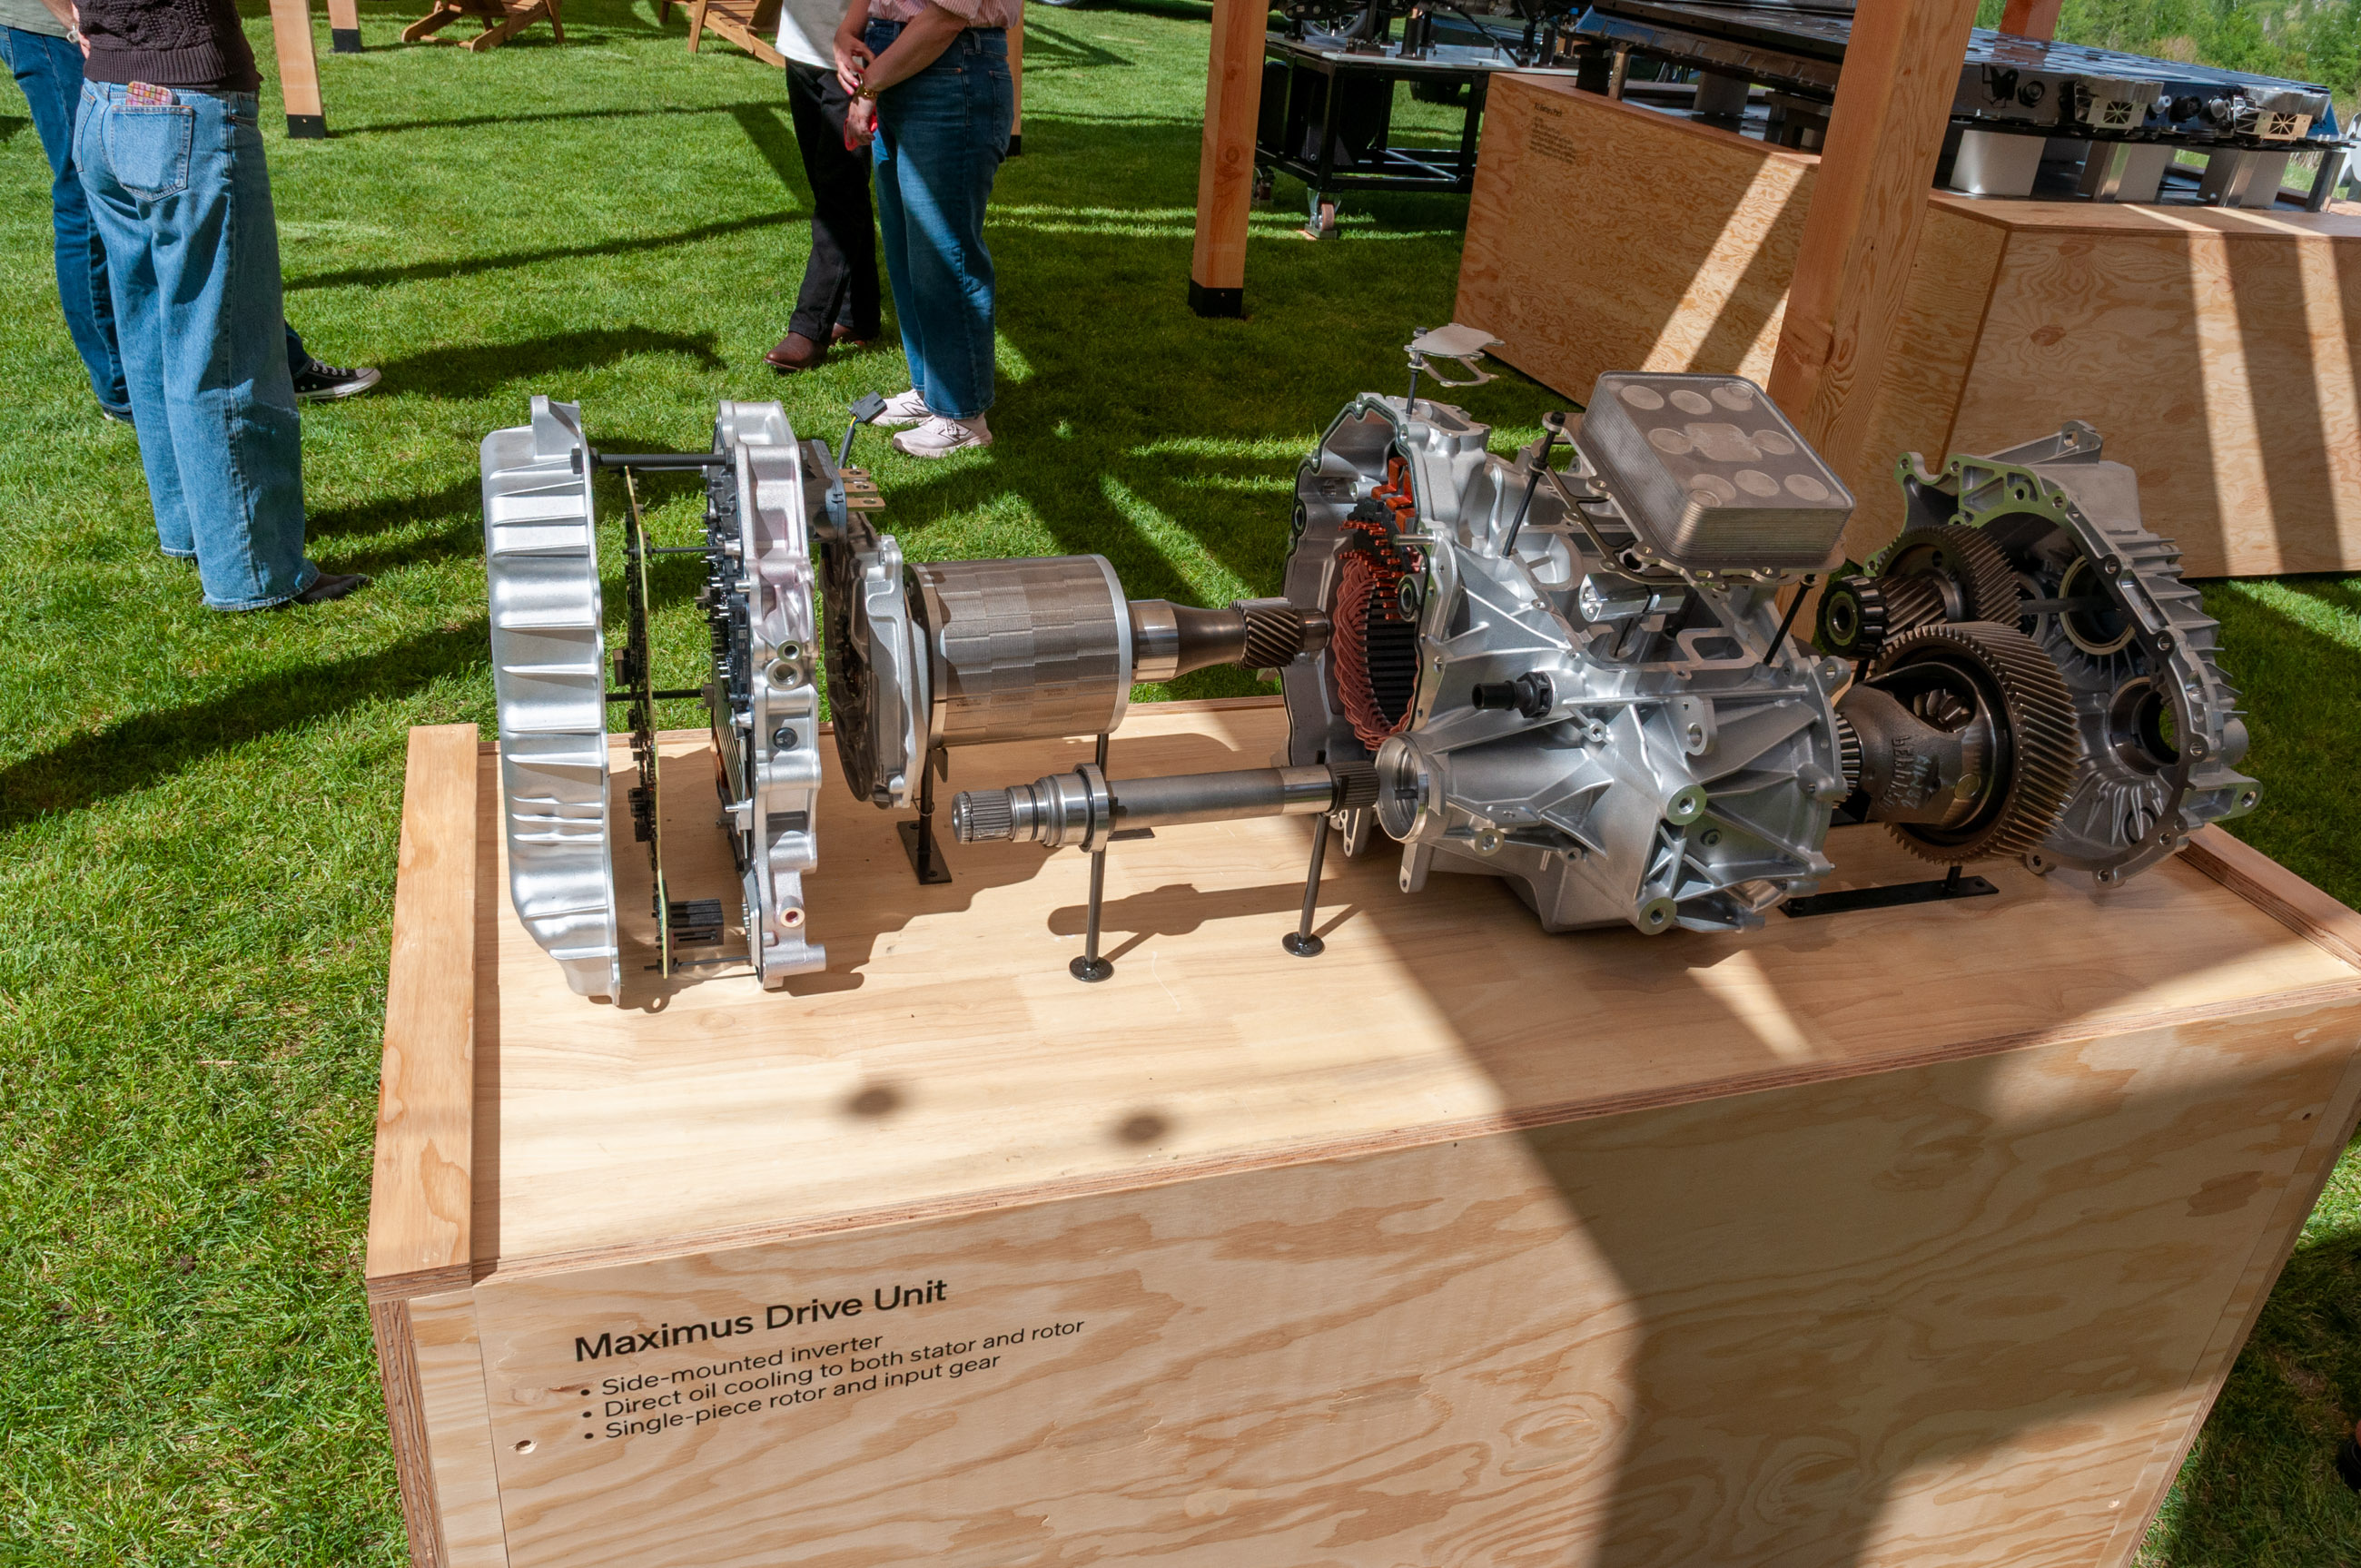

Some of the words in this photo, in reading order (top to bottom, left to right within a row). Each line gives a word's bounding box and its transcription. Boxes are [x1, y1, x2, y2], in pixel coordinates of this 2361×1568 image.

[575, 1316, 754, 1362] Maximus
[766, 1298, 864, 1330] Drive
[874, 1279, 948, 1311] Unit
[602, 1349, 783, 1395] Side-mounted
[791, 1336, 884, 1364] inverter
[605, 1389, 682, 1417] Direct
[688, 1382, 716, 1402] oil
[724, 1369, 813, 1395] cooling
[819, 1364, 844, 1378] to
[850, 1350, 904, 1374] both
[910, 1339, 977, 1363] stator
[983, 1327, 1024, 1349] and
[1032, 1321, 1085, 1341] rotor
[606, 1399, 762, 1438] Single-piece
[769, 1385, 827, 1408] rotor
[833, 1375, 877, 1396] and
[884, 1363, 943, 1387] input
[949, 1356, 1001, 1378] gear
